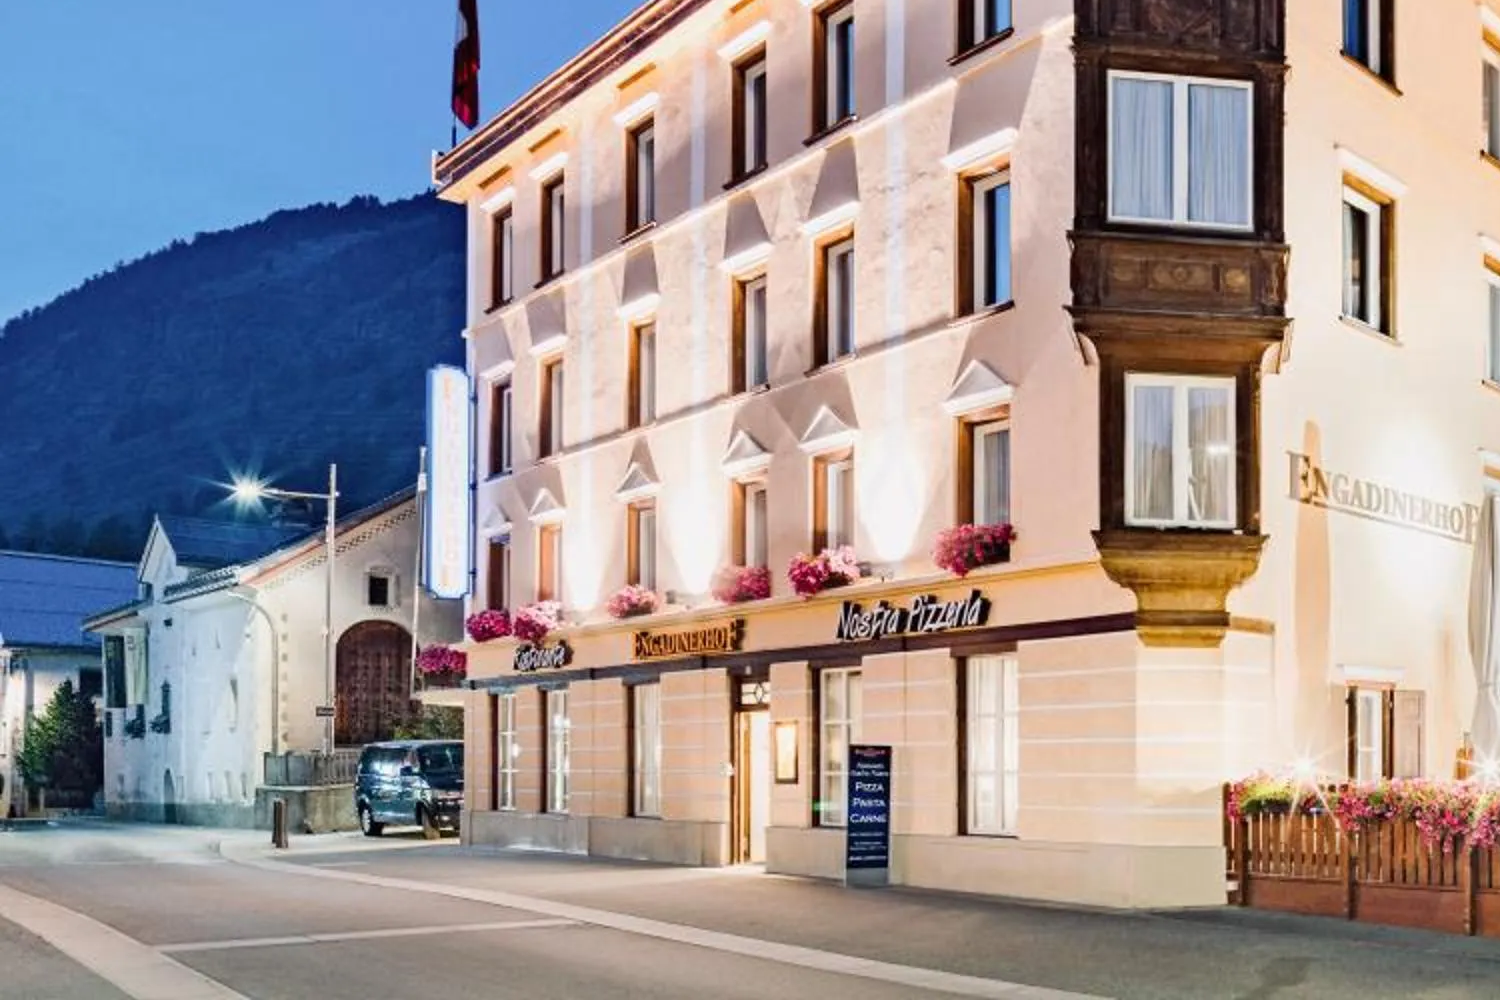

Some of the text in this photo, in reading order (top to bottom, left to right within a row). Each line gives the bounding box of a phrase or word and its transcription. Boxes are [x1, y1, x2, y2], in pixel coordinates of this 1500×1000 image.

[1286, 451, 1480, 542] ENGADINERHOF
[835, 594, 985, 641] Nostra Pizzeria
